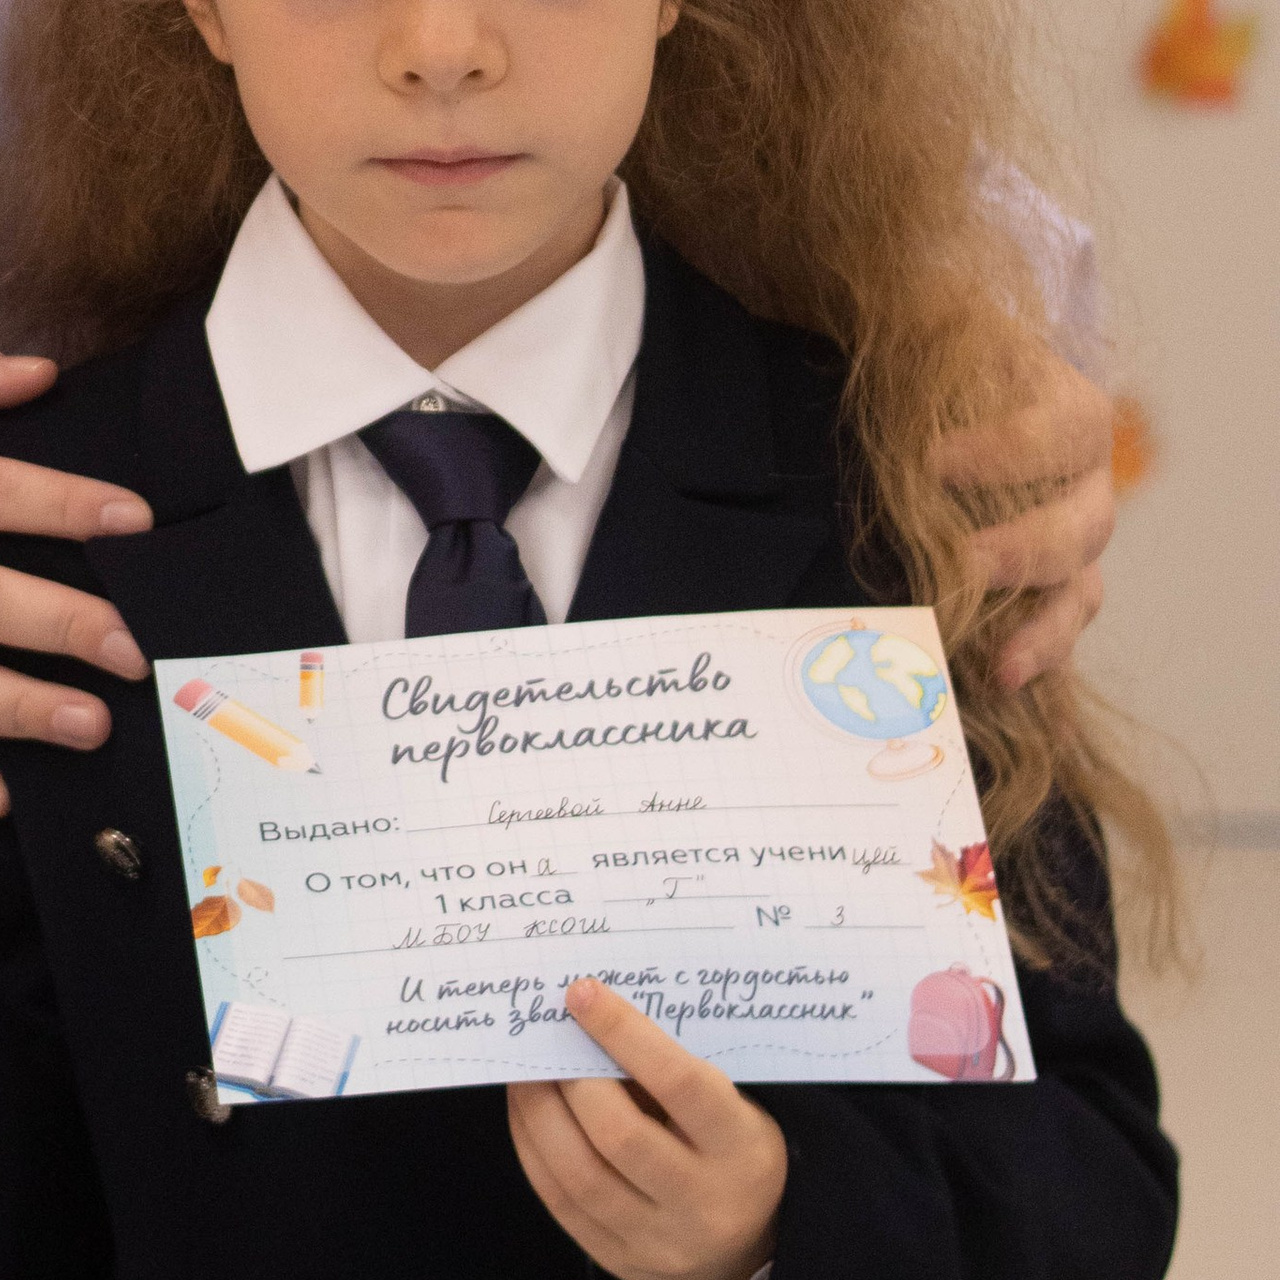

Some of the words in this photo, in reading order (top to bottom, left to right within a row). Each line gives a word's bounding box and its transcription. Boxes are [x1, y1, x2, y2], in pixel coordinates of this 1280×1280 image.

[381, 652, 731, 732] Свидетельство
[391, 715, 759, 783] первоклассника
[260, 816, 400, 842] Выдано:
[305, 872, 331, 893] О
[340, 870, 410, 890] том,
[420, 863, 476, 883] что
[592, 844, 741, 869] является
[434, 893, 448, 914] 1
[460, 888, 575, 913] класса
[755, 904, 792, 927] №
[830, 905, 846, 926] 3
[400, 975, 424, 1003] И
[437, 975, 546, 1008] теперь
[557, 966, 668, 990] мжет
[674, 969, 690, 985] с
[697, 965, 850, 1002] гордостью
[386, 1009, 496, 1035] носить
